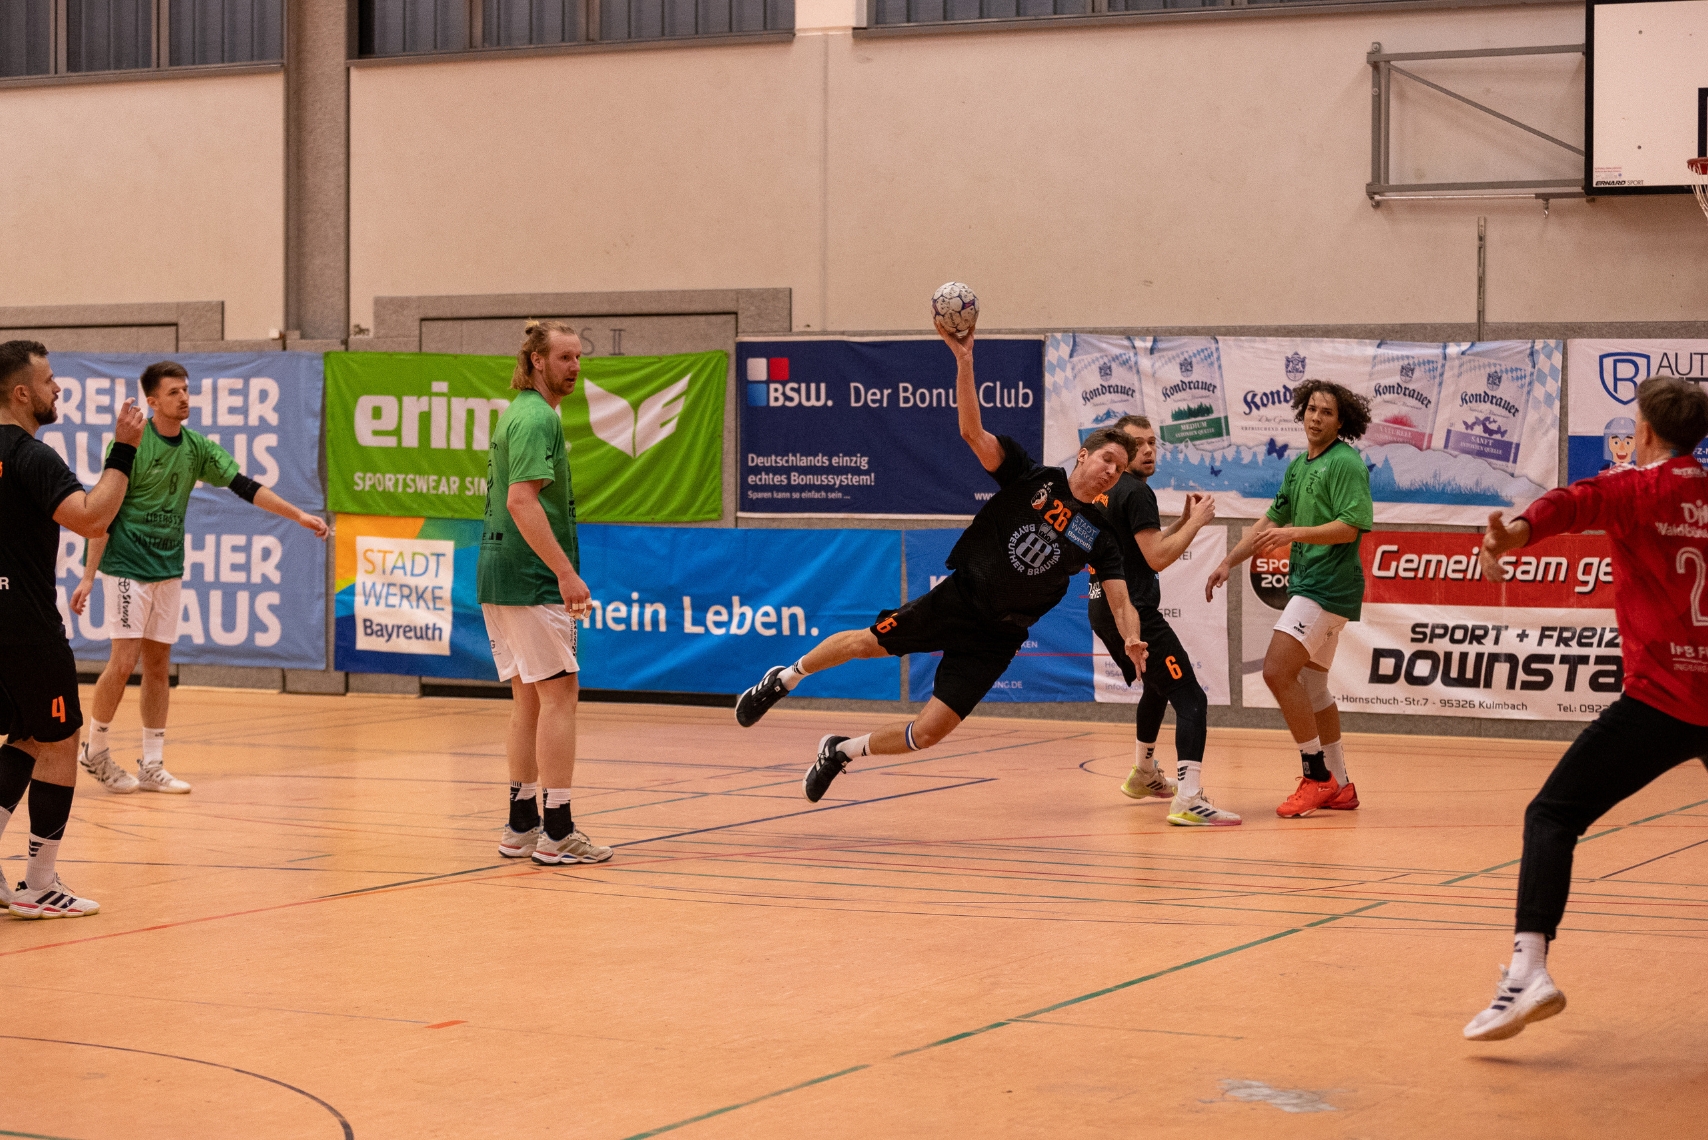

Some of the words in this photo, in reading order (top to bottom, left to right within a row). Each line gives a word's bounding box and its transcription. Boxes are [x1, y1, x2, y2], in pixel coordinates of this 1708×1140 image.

[769, 381, 834, 408] BSW.
[850, 381, 892, 408] Der
[1081, 383, 1136, 406] Kondrauer
[1161, 379, 1217, 402] Kondrauer
[1373, 382, 1432, 409] Kondrauer
[354, 381, 511, 451] erim
[1458, 390, 1520, 418] Kondrauer
[1180, 420, 1208, 431] MEDIUM
[748, 453, 829, 467] Deutschlands
[831, 453, 870, 470] einzig
[168, 472, 179, 496] 8
[354, 472, 460, 496] SPORTSWEAR
[747, 471, 788, 485] echtes
[790, 471, 875, 488] Bonussystem!
[747, 490, 772, 500] Sparen
[773, 490, 791, 499] kann
[792, 491, 800, 499] so
[801, 490, 826, 499] einfach
[827, 490, 842, 499] sein
[1043, 499, 1072, 532] 26
[1008, 523, 1036, 573] BAYREUTHER
[1027, 542, 1060, 576] BRAUHAUS
[362, 547, 447, 578] STADT
[1371, 545, 1568, 582] Gemeisam
[361, 581, 446, 612] WERKE
[683, 595, 820, 637] Leben.
[362, 618, 444, 643] Bayreuth
[1410, 622, 1509, 646] SPORT
[1165, 655, 1183, 680] 6
[51, 695, 66, 723] 4
[1439, 698, 1476, 710] 95326
[1478, 700, 1528, 712] Kulmbach
[1557, 703, 1577, 713] Tel.:
